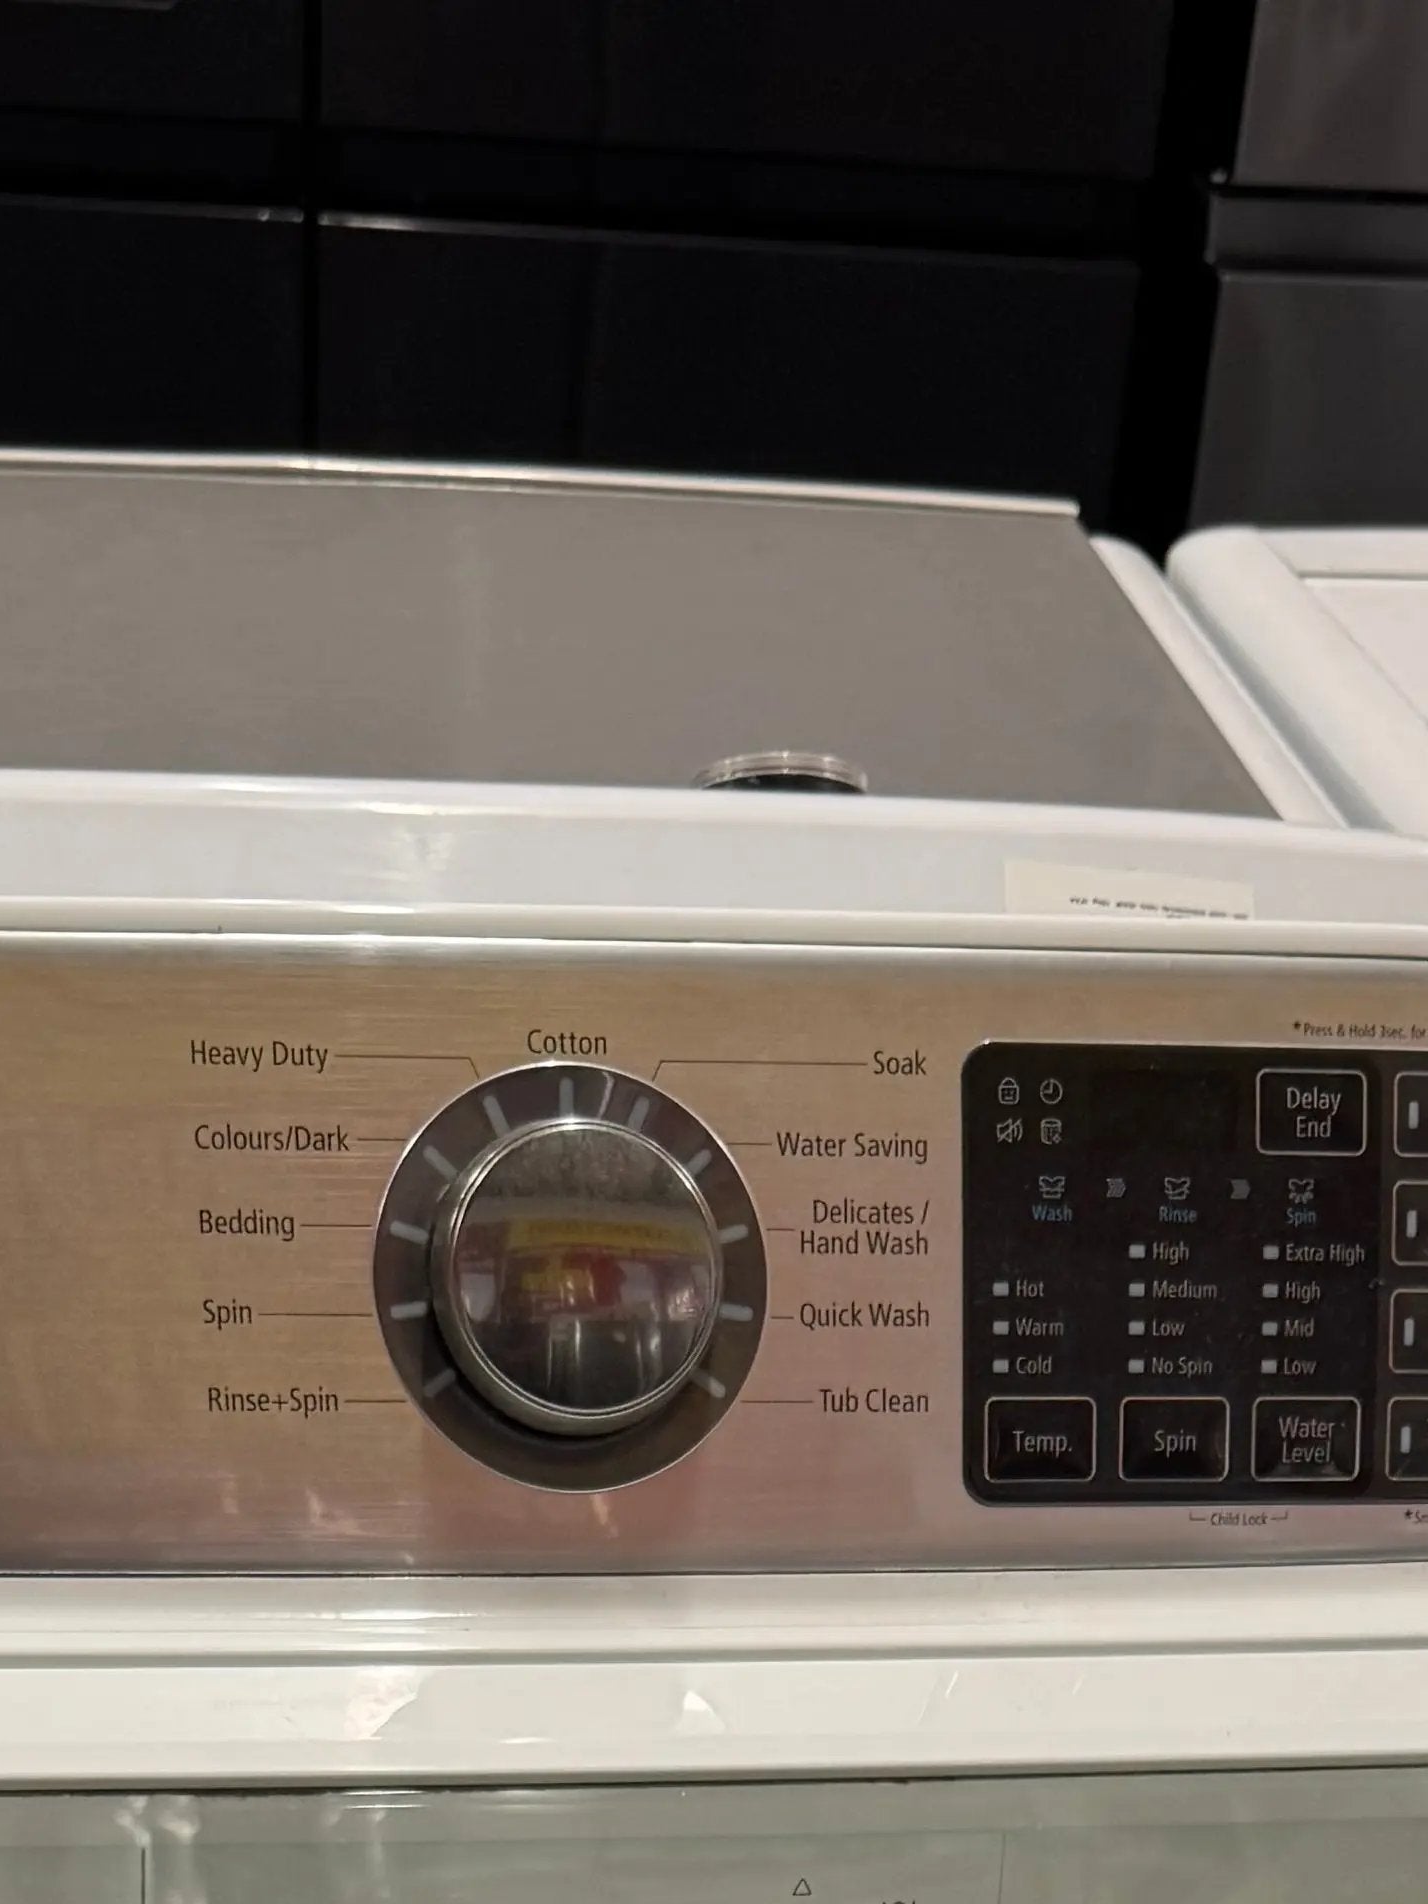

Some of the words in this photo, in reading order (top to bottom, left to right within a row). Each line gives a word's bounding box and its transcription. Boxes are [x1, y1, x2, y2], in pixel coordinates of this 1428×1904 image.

[527, 1029, 607, 1055] Cotton
[1303, 1022, 1333, 1037] Press
[190, 1039, 264, 1073] Heavy
[272, 1040, 328, 1074] Duty
[873, 1049, 927, 1076] Soak
[1286, 1086, 1342, 1116] Delay
[194, 1123, 349, 1152] Colours/Dark
[1296, 1114, 1332, 1138] End
[776, 1131, 847, 1157] Water
[853, 1132, 928, 1165] Saving
[812, 1197, 914, 1225] Delicates
[1031, 1204, 1073, 1222] Wash
[1158, 1205, 1197, 1223] Rinse
[1286, 1207, 1317, 1228] Spin
[199, 1207, 295, 1242] Bedding
[800, 1229, 859, 1255] Hand
[865, 1229, 929, 1256] Wash
[1152, 1240, 1189, 1265] High
[1285, 1242, 1325, 1262] Extra
[1329, 1243, 1365, 1267] High
[1016, 1279, 1044, 1298] Hot
[1152, 1279, 1218, 1299] Medium
[1285, 1280, 1321, 1304] High
[202, 1298, 252, 1331] Spin
[799, 1300, 863, 1331] Quick
[868, 1301, 930, 1327] Wash
[1015, 1317, 1064, 1336] Warm
[1284, 1317, 1315, 1337] Mid
[1152, 1319, 1185, 1337] Low
[1016, 1355, 1053, 1375] Cold
[1151, 1356, 1174, 1375] No
[1178, 1356, 1213, 1378] Spin
[1283, 1357, 1317, 1375] Low
[208, 1385, 339, 1419] Rinse+Spin
[819, 1387, 859, 1413] Tub
[865, 1387, 929, 1413] Clean
[1278, 1416, 1336, 1439] Water
[1012, 1430, 1073, 1457] Temp.
[1154, 1429, 1197, 1458] Spin
[1282, 1440, 1331, 1464] Level
